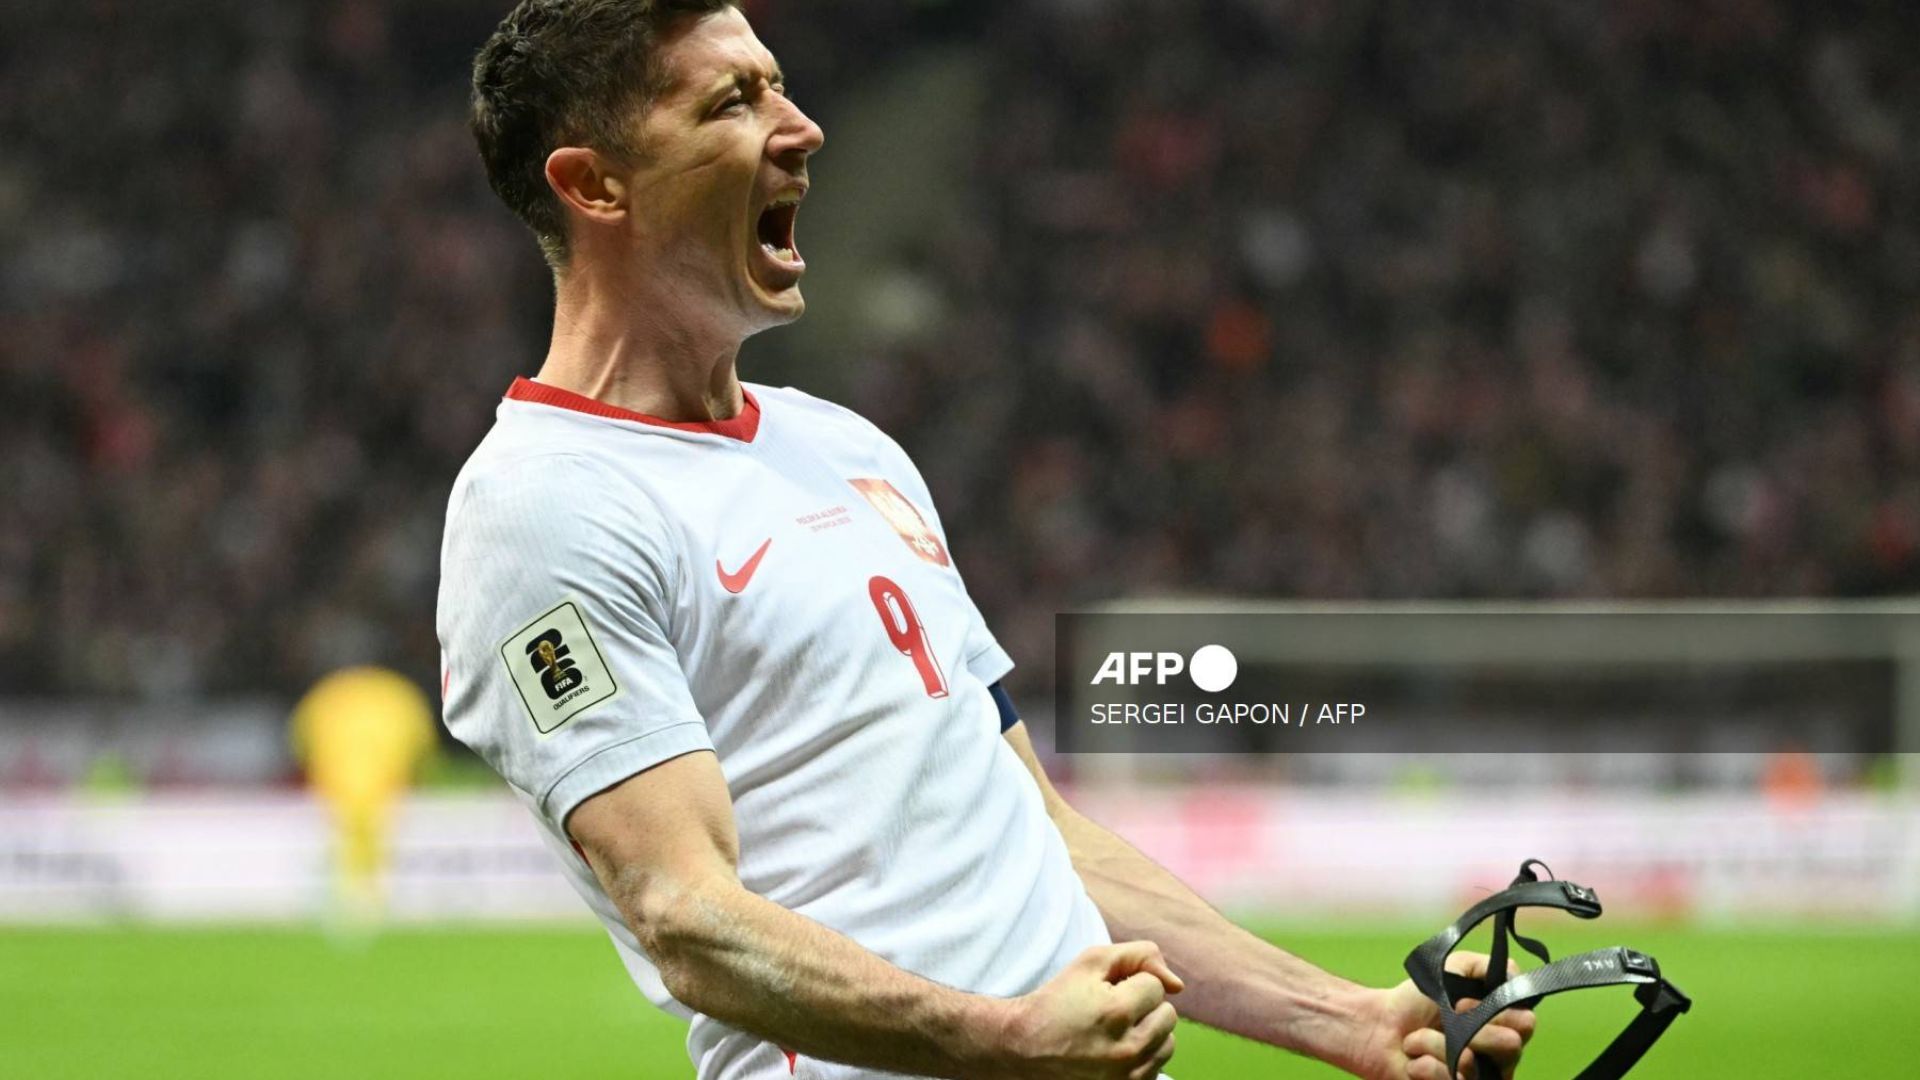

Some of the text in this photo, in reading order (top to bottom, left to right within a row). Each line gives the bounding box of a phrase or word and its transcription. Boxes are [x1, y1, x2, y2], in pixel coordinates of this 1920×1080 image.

[868, 575, 949, 698] 9
[554, 677, 574, 692] FIFA
[553, 685, 590, 711] QUALIFIERS
